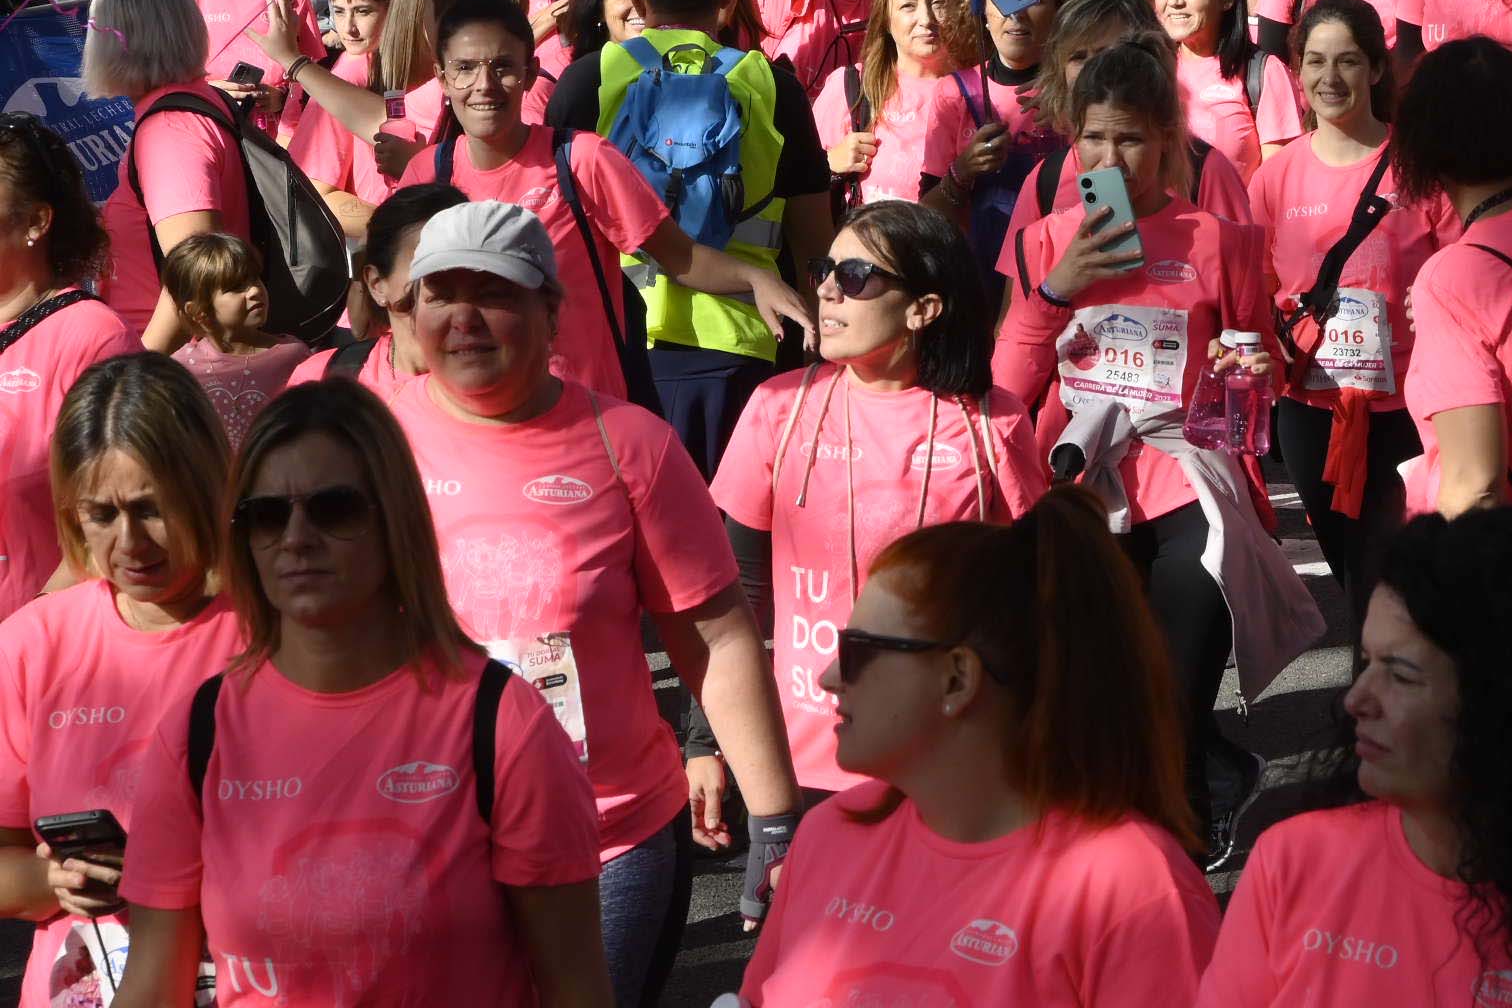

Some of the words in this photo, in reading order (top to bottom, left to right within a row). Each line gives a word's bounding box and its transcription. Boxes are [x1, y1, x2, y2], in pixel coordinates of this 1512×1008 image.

[1427, 23, 1447, 42] TU
[83, 99, 134, 125] LECHER
[883, 110, 915, 122] YSHO
[1286, 203, 1328, 220] OYSHO
[1099, 324, 1144, 339] ASTURIANA
[1152, 323, 1180, 332] SUMA
[1328, 328, 1365, 345] 016
[1104, 347, 1145, 368] 016
[1333, 347, 1361, 357] 23732
[1105, 369, 1140, 383] 25483
[1074, 380, 1105, 392] CARRERA
[1129, 389, 1152, 399] MUJER
[529, 485, 587, 498] ASTURIANA
[790, 566, 829, 604] TU
[529, 655, 561, 667] SUMA
[48, 704, 126, 730] OYSHO
[217, 776, 303, 802] OYSHO
[384, 776, 452, 794] ASTURIANA
[824, 895, 894, 933] OYSHO
[1301, 926, 1400, 970] OYSHO
[220, 952, 280, 997] TU
